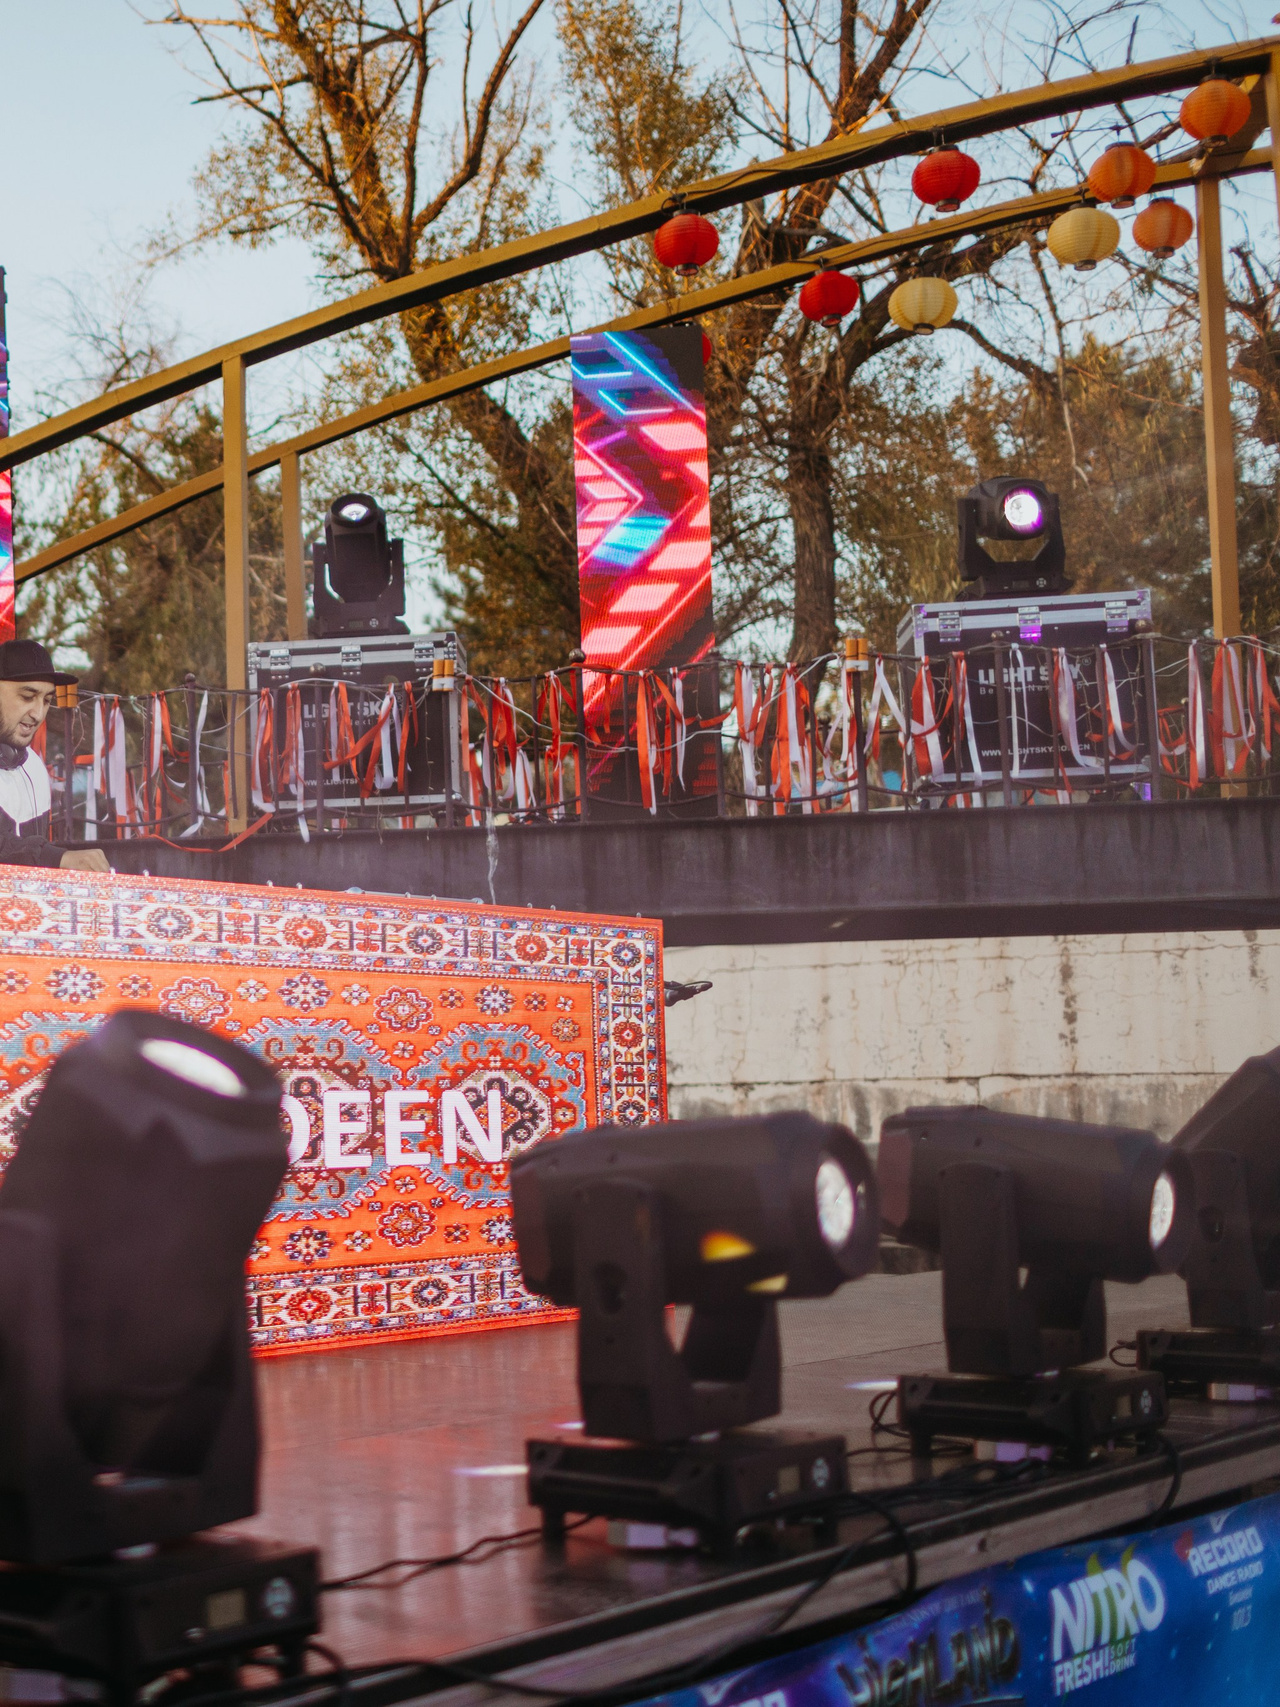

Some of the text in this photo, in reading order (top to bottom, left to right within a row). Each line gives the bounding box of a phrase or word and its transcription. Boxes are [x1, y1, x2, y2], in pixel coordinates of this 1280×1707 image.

[1039, 663, 1081, 682] SY
[303, 700, 387, 719] LIGT SK
[1188, 1526, 1264, 1577] RECORD
[1206, 1561, 1264, 1595] DANCE RADIO
[1051, 1559, 1165, 1663] NITRO
[1109, 1637, 1137, 1659] SOFT
[1054, 1645, 1109, 1697] FRESH!
[1109, 1652, 1136, 1676] DRINK
